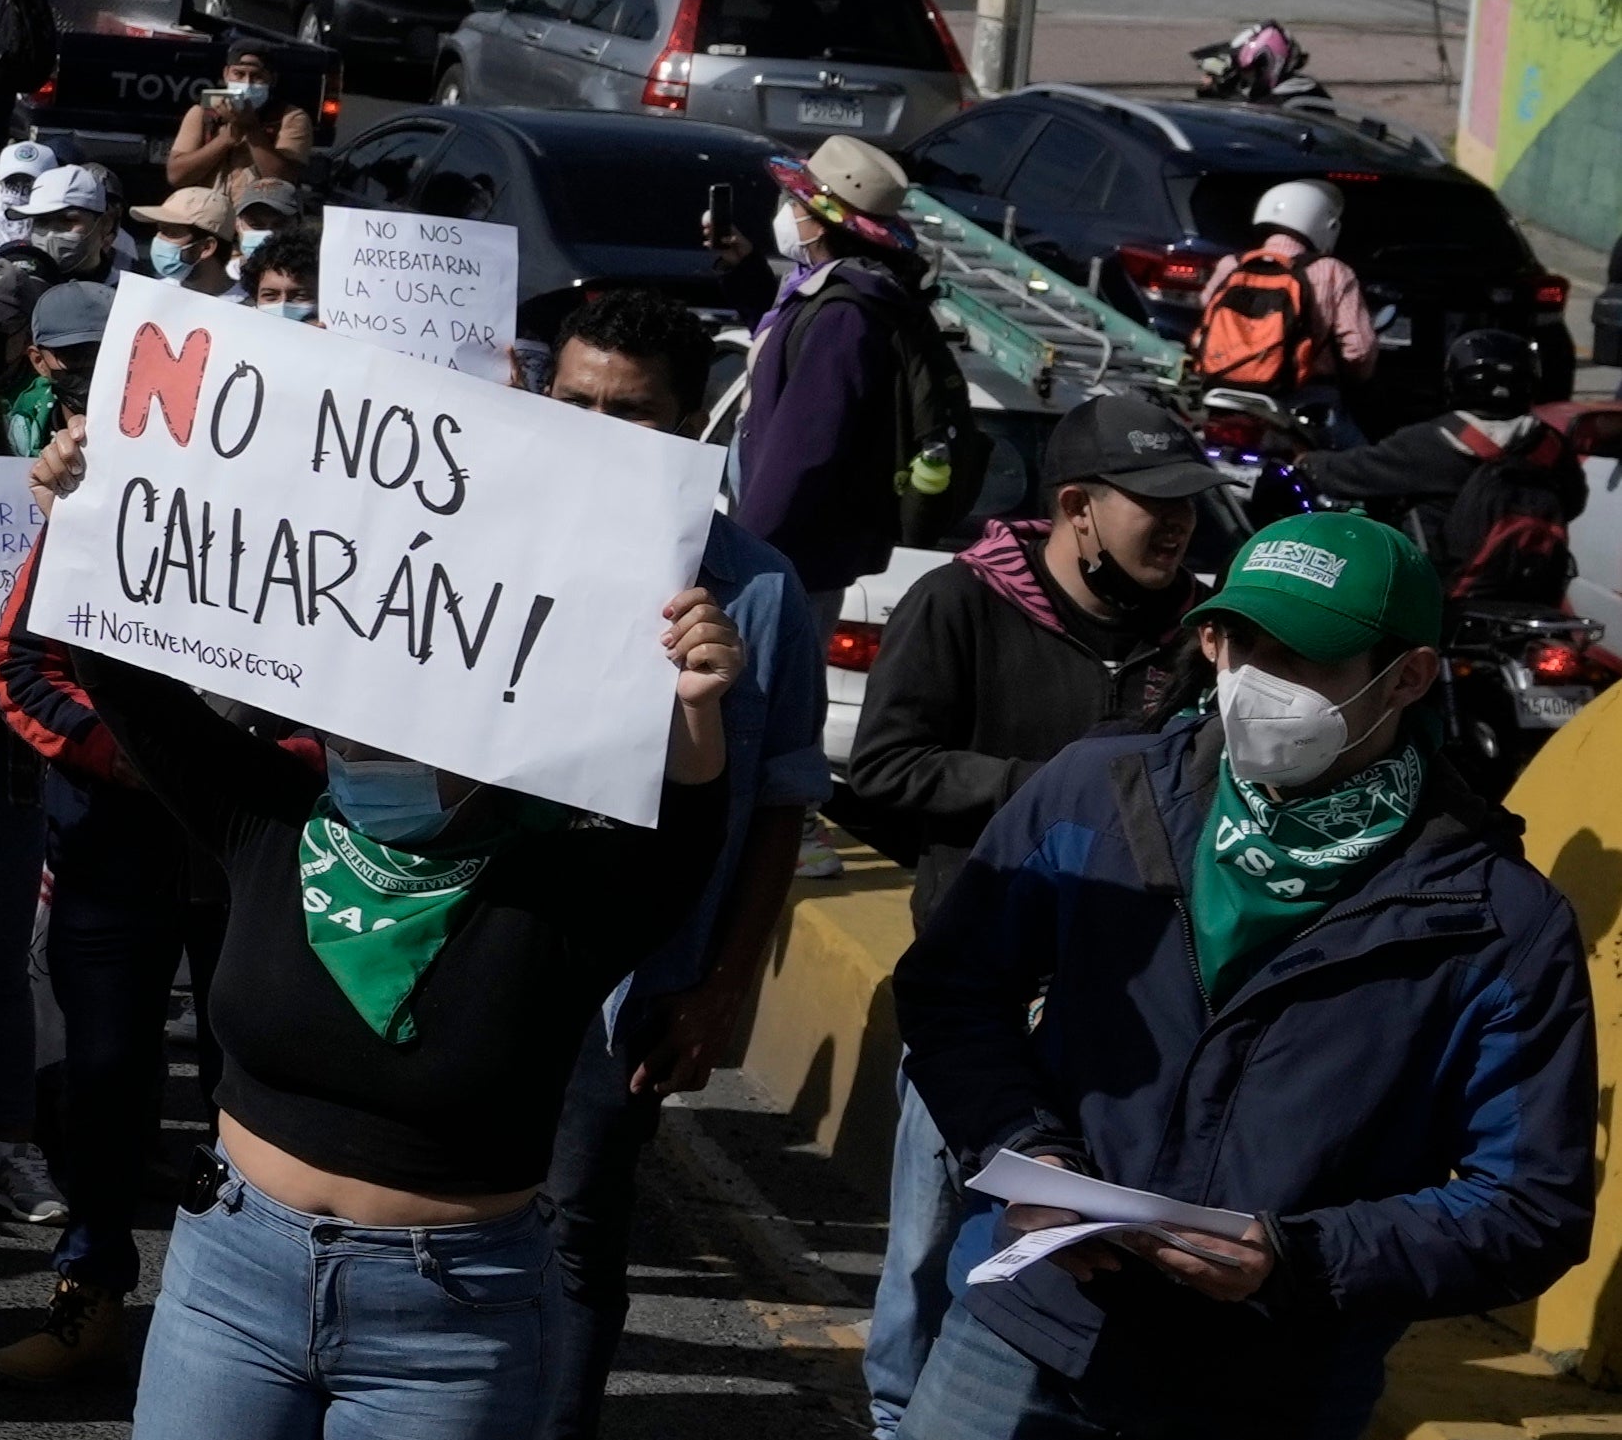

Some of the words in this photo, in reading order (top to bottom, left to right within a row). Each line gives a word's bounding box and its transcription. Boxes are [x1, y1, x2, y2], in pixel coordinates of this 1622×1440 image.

[365, 219, 397, 240] NO
[419, 223, 463, 245] NOS
[352, 248, 481, 277] ARREBATARAN
[344, 277, 371, 299] LA
[327, 308, 407, 336] VAMOS
[420, 319, 439, 338] A
[450, 319, 497, 349] DAR
[117, 319, 266, 460] NO
[311, 388, 470, 518] NOS
[67, 605, 305, 690] #NOTENEMOSRECTOR
